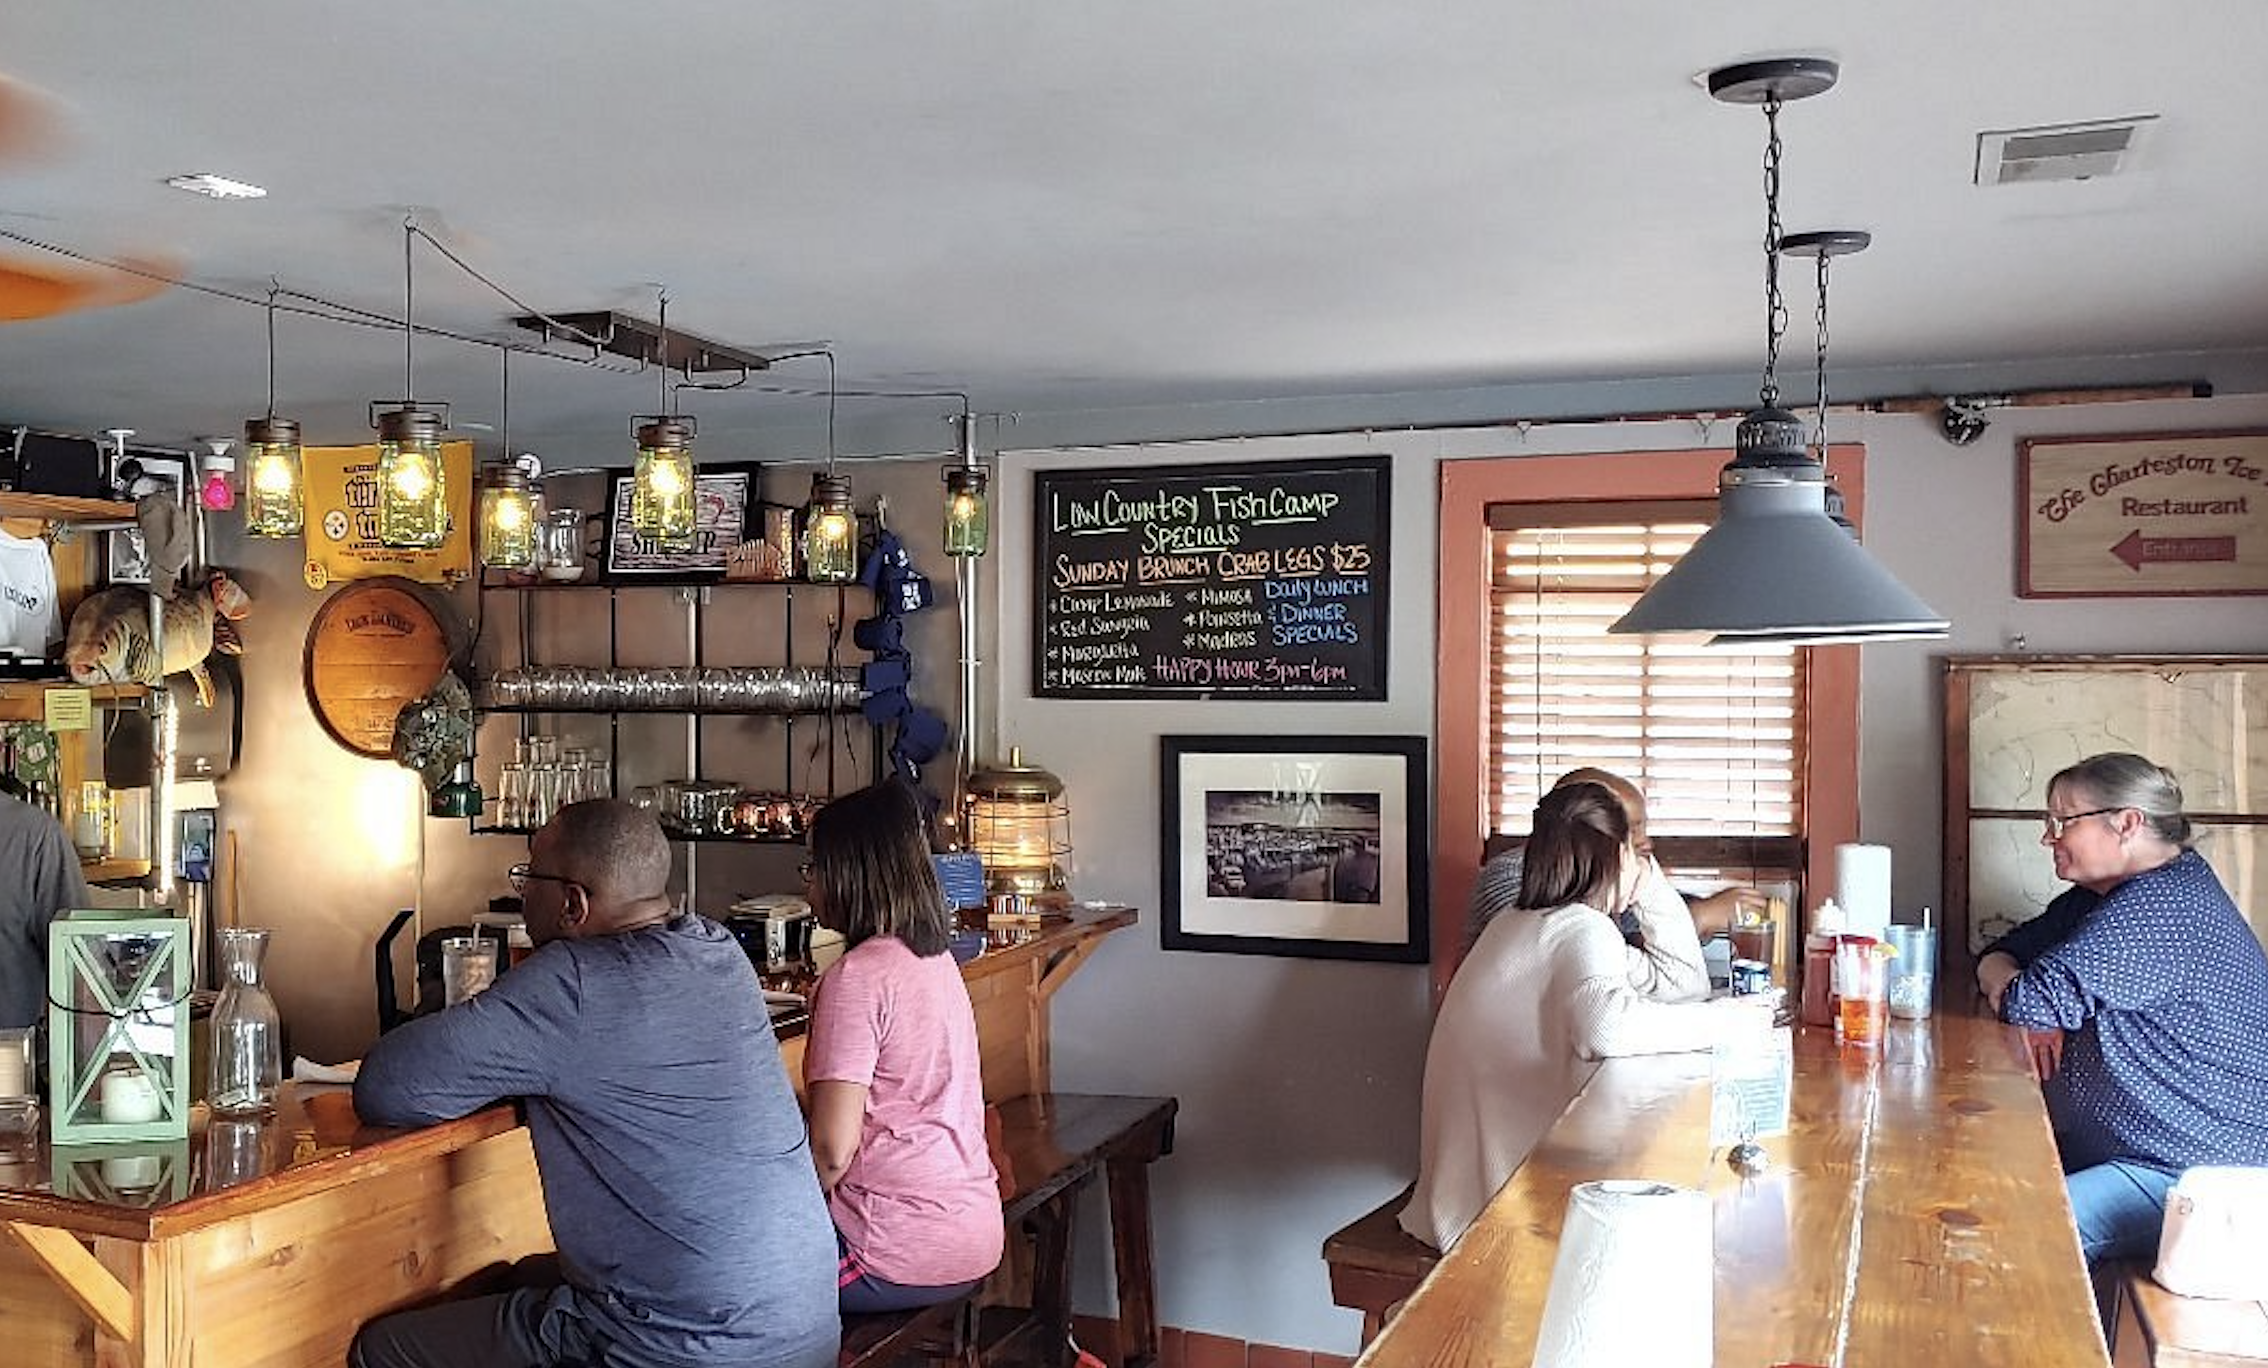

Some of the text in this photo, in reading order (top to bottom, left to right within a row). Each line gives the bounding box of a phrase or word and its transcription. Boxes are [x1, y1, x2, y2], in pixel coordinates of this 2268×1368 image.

[2037, 453, 2262, 522] The Charleston Ice
[2121, 496, 2249, 517] Restaurant
[1052, 540, 1372, 588] SUNDAY BRUNCH CRAB LEGS $25
[1272, 621, 1359, 647] SPECIALS
[1152, 654, 1213, 685] HAPPY
[1214, 656, 1262, 681] HOUR
